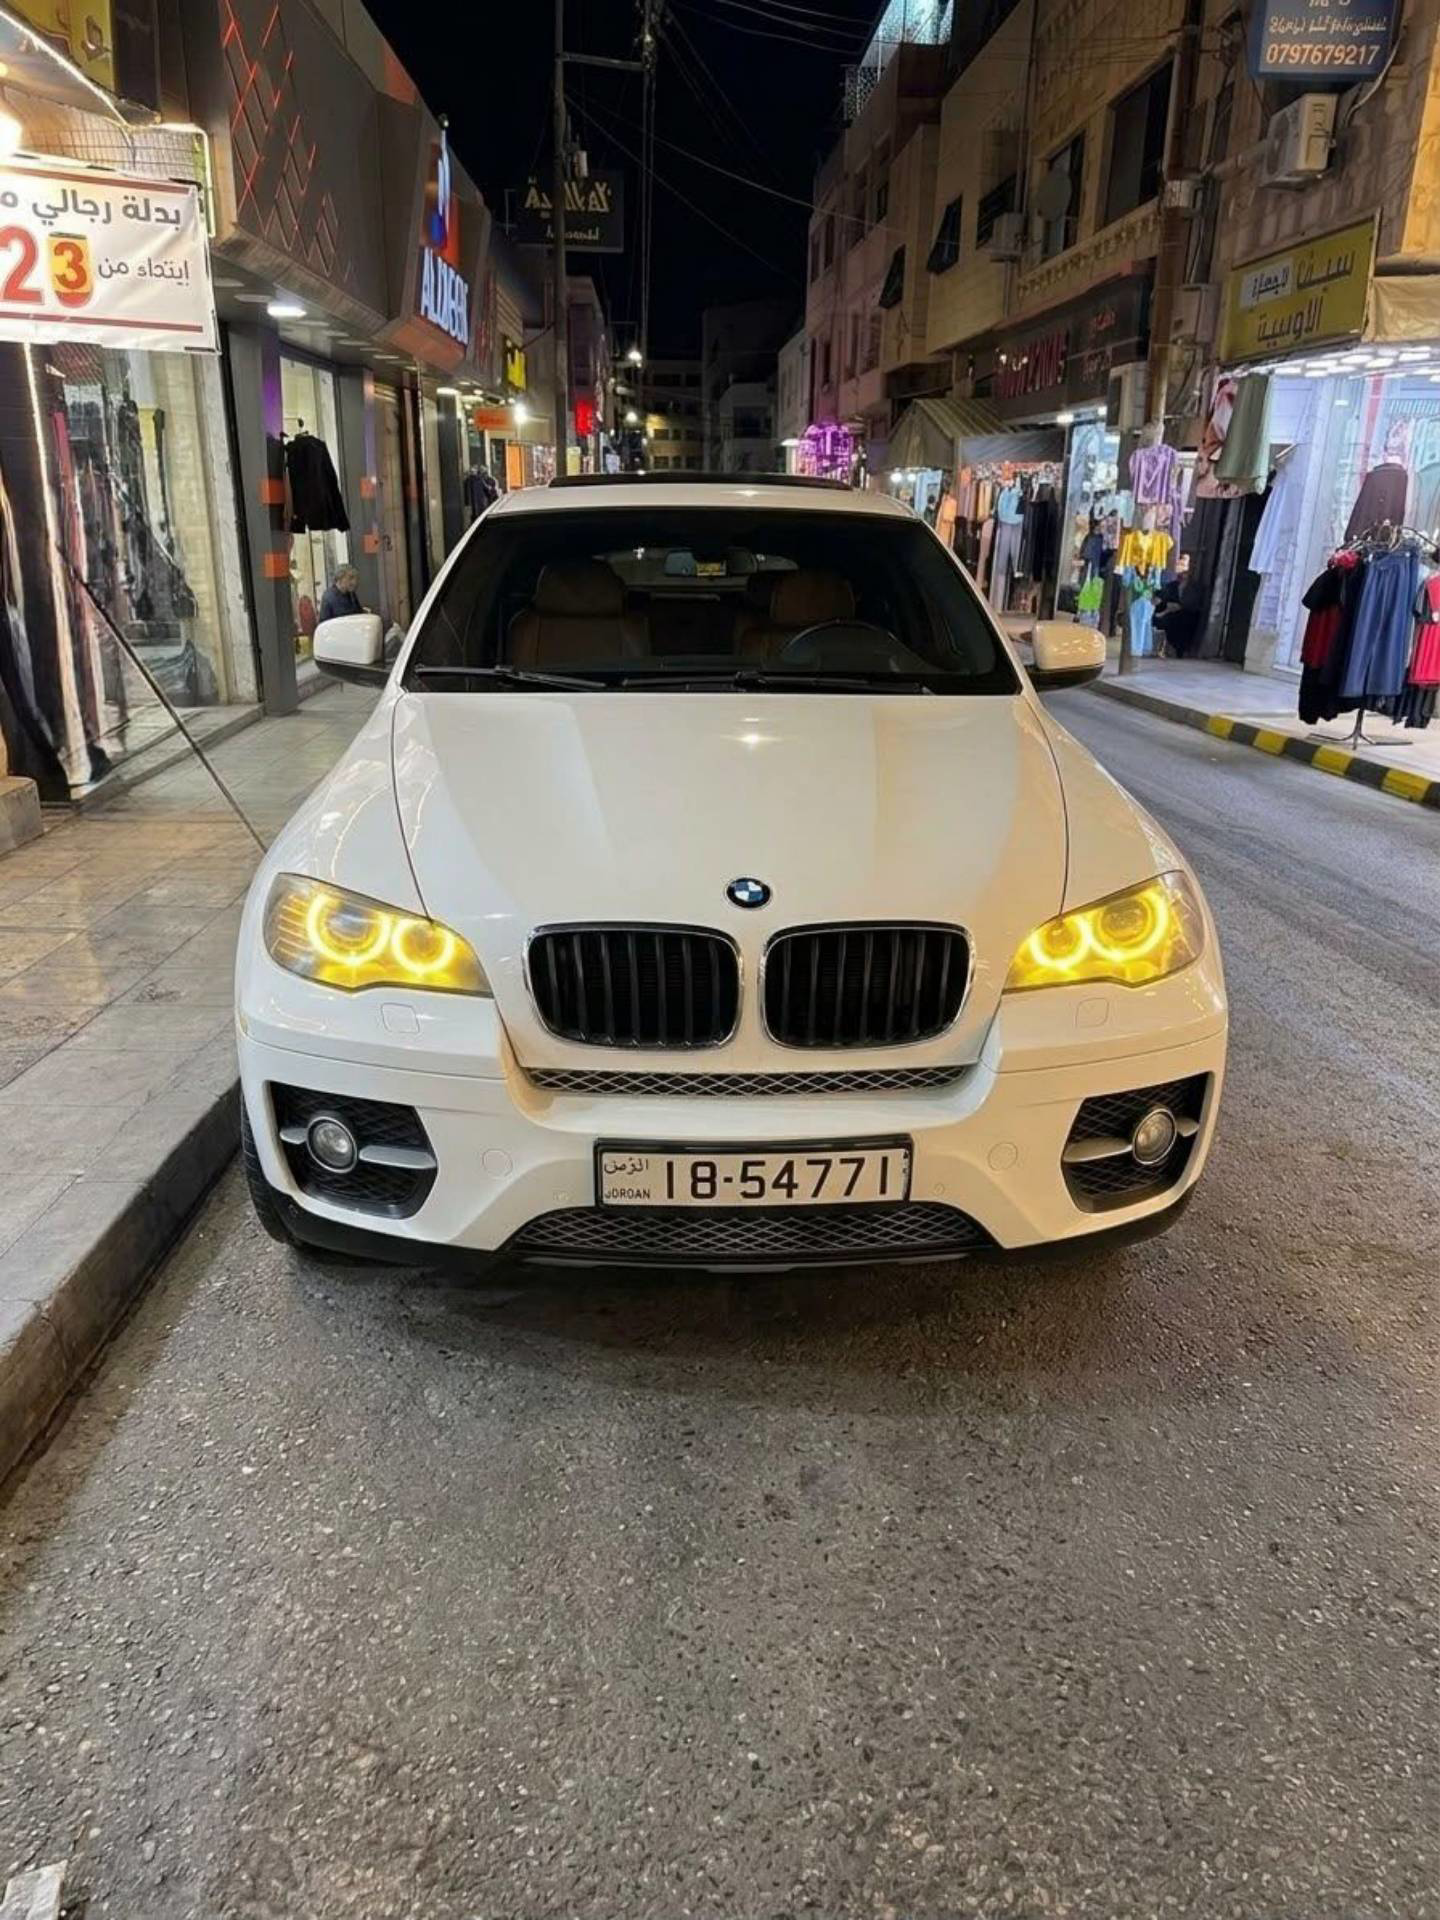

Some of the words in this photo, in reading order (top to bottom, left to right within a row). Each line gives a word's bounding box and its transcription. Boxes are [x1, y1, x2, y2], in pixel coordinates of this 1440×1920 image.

[1266, 43, 1380, 65] 0797679217
[32, 188, 113, 226] رجالي
[122, 195, 182, 231] بدلة
[98, 258, 130, 279] من
[667, 1156, 888, 1200] 18-54771
[604, 1187, 651, 1200] JORDAN
